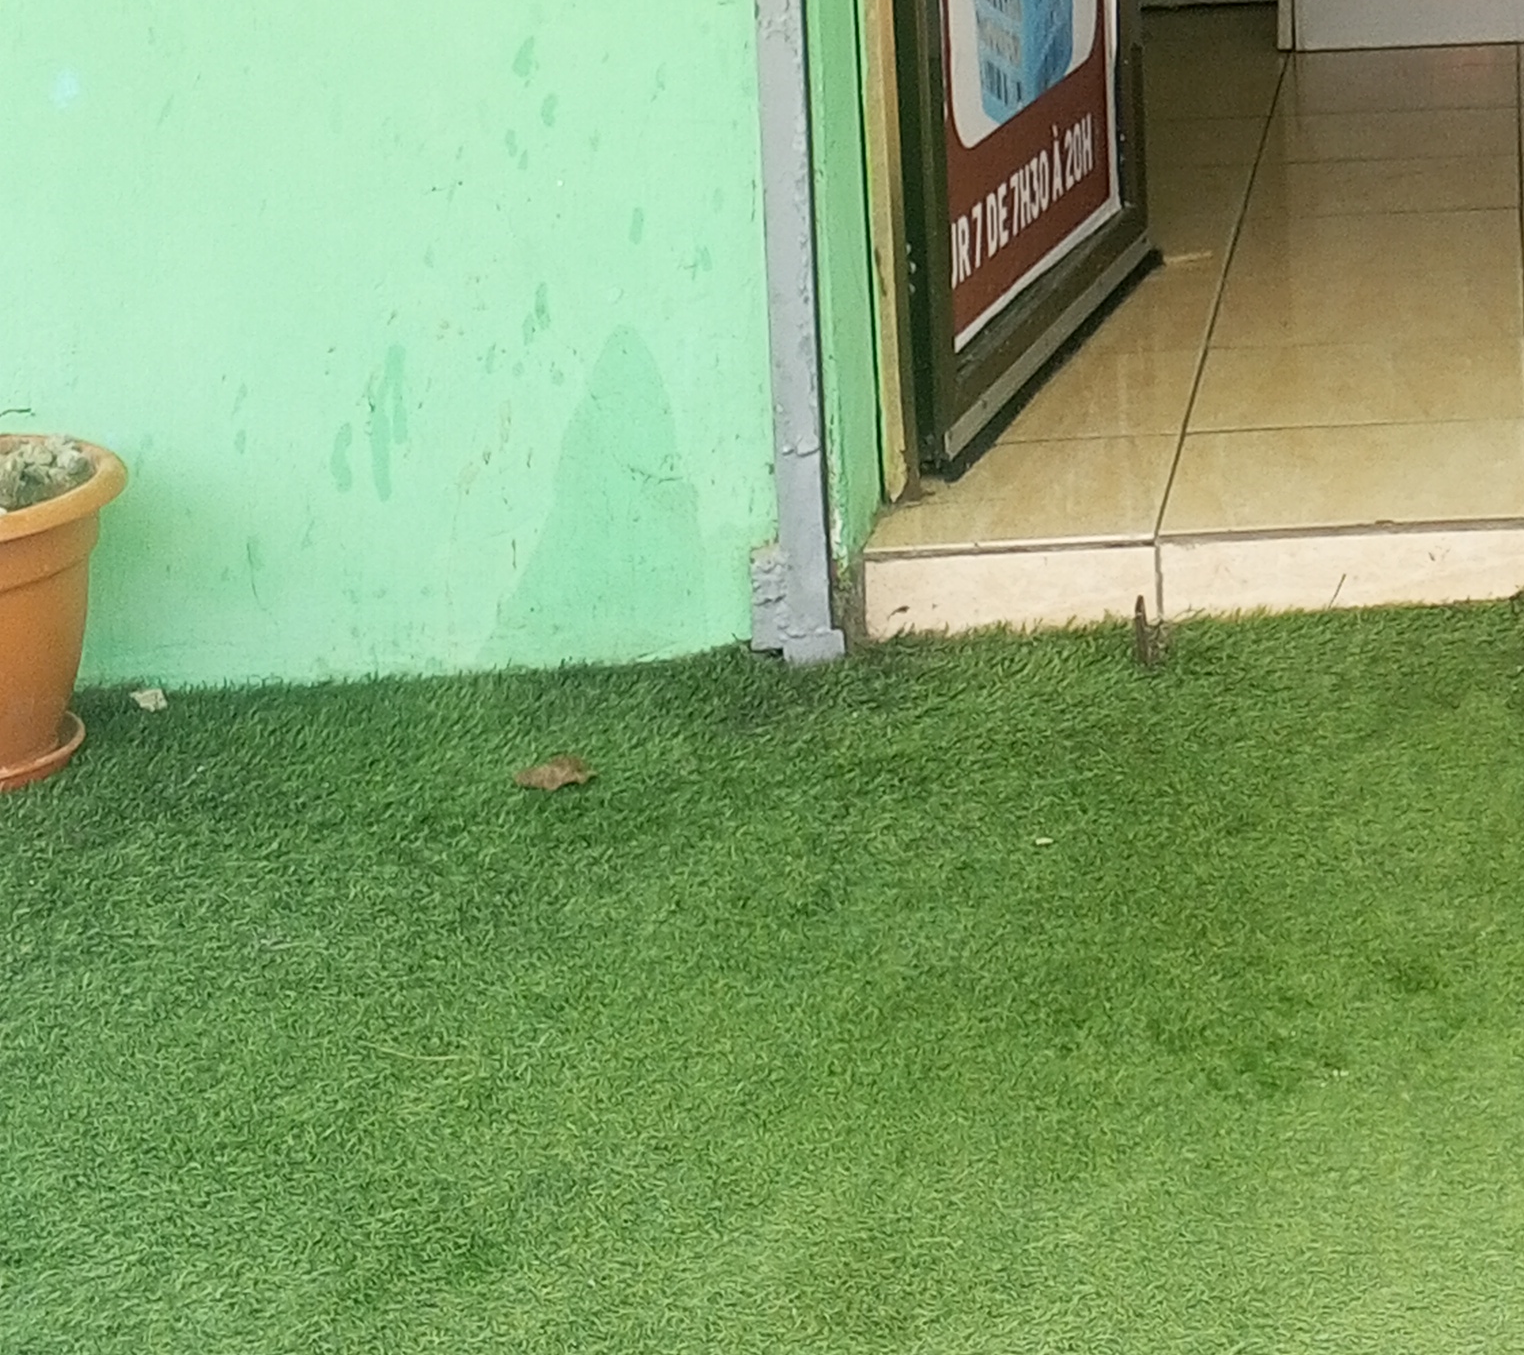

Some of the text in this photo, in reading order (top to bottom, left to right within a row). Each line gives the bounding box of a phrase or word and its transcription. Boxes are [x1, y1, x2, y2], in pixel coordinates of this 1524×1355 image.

[971, 202, 983, 269] 7
[986, 182, 1010, 258] DE
[1010, 149, 1050, 236] 7H30
[1052, 124, 1064, 202] À
[1064, 112, 1094, 191] 20H
